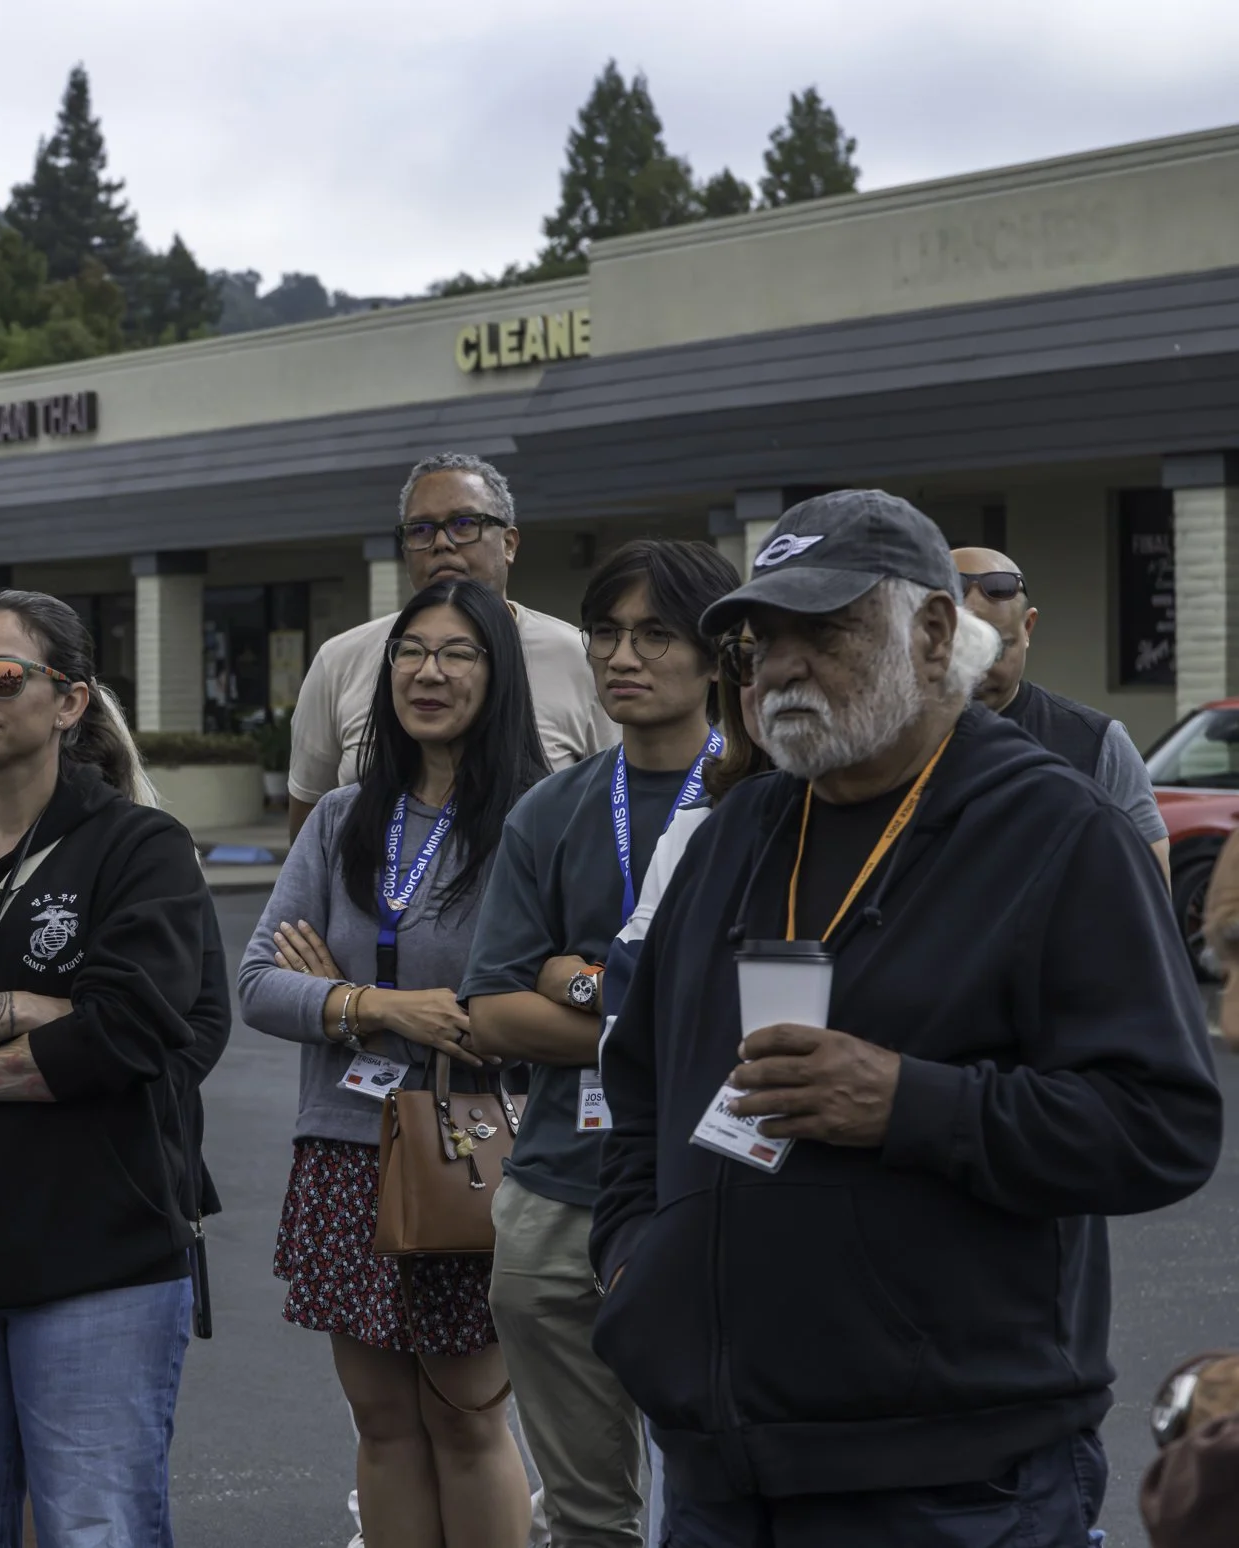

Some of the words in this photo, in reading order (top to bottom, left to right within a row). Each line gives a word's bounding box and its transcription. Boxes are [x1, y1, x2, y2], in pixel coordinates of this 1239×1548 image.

[455, 308, 590, 373] CLEANE
[614, 766, 625, 805] Since
[387, 824, 402, 862] Since
[614, 808, 628, 853] MINIS
[397, 857, 428, 904] NorCal
[422, 818, 451, 856] MINIS
[382, 865, 397, 898] 2003
[22, 954, 47, 973] CAMP
[57, 949, 85, 974] MUJUK
[358, 1055, 381, 1067] TRISHA
